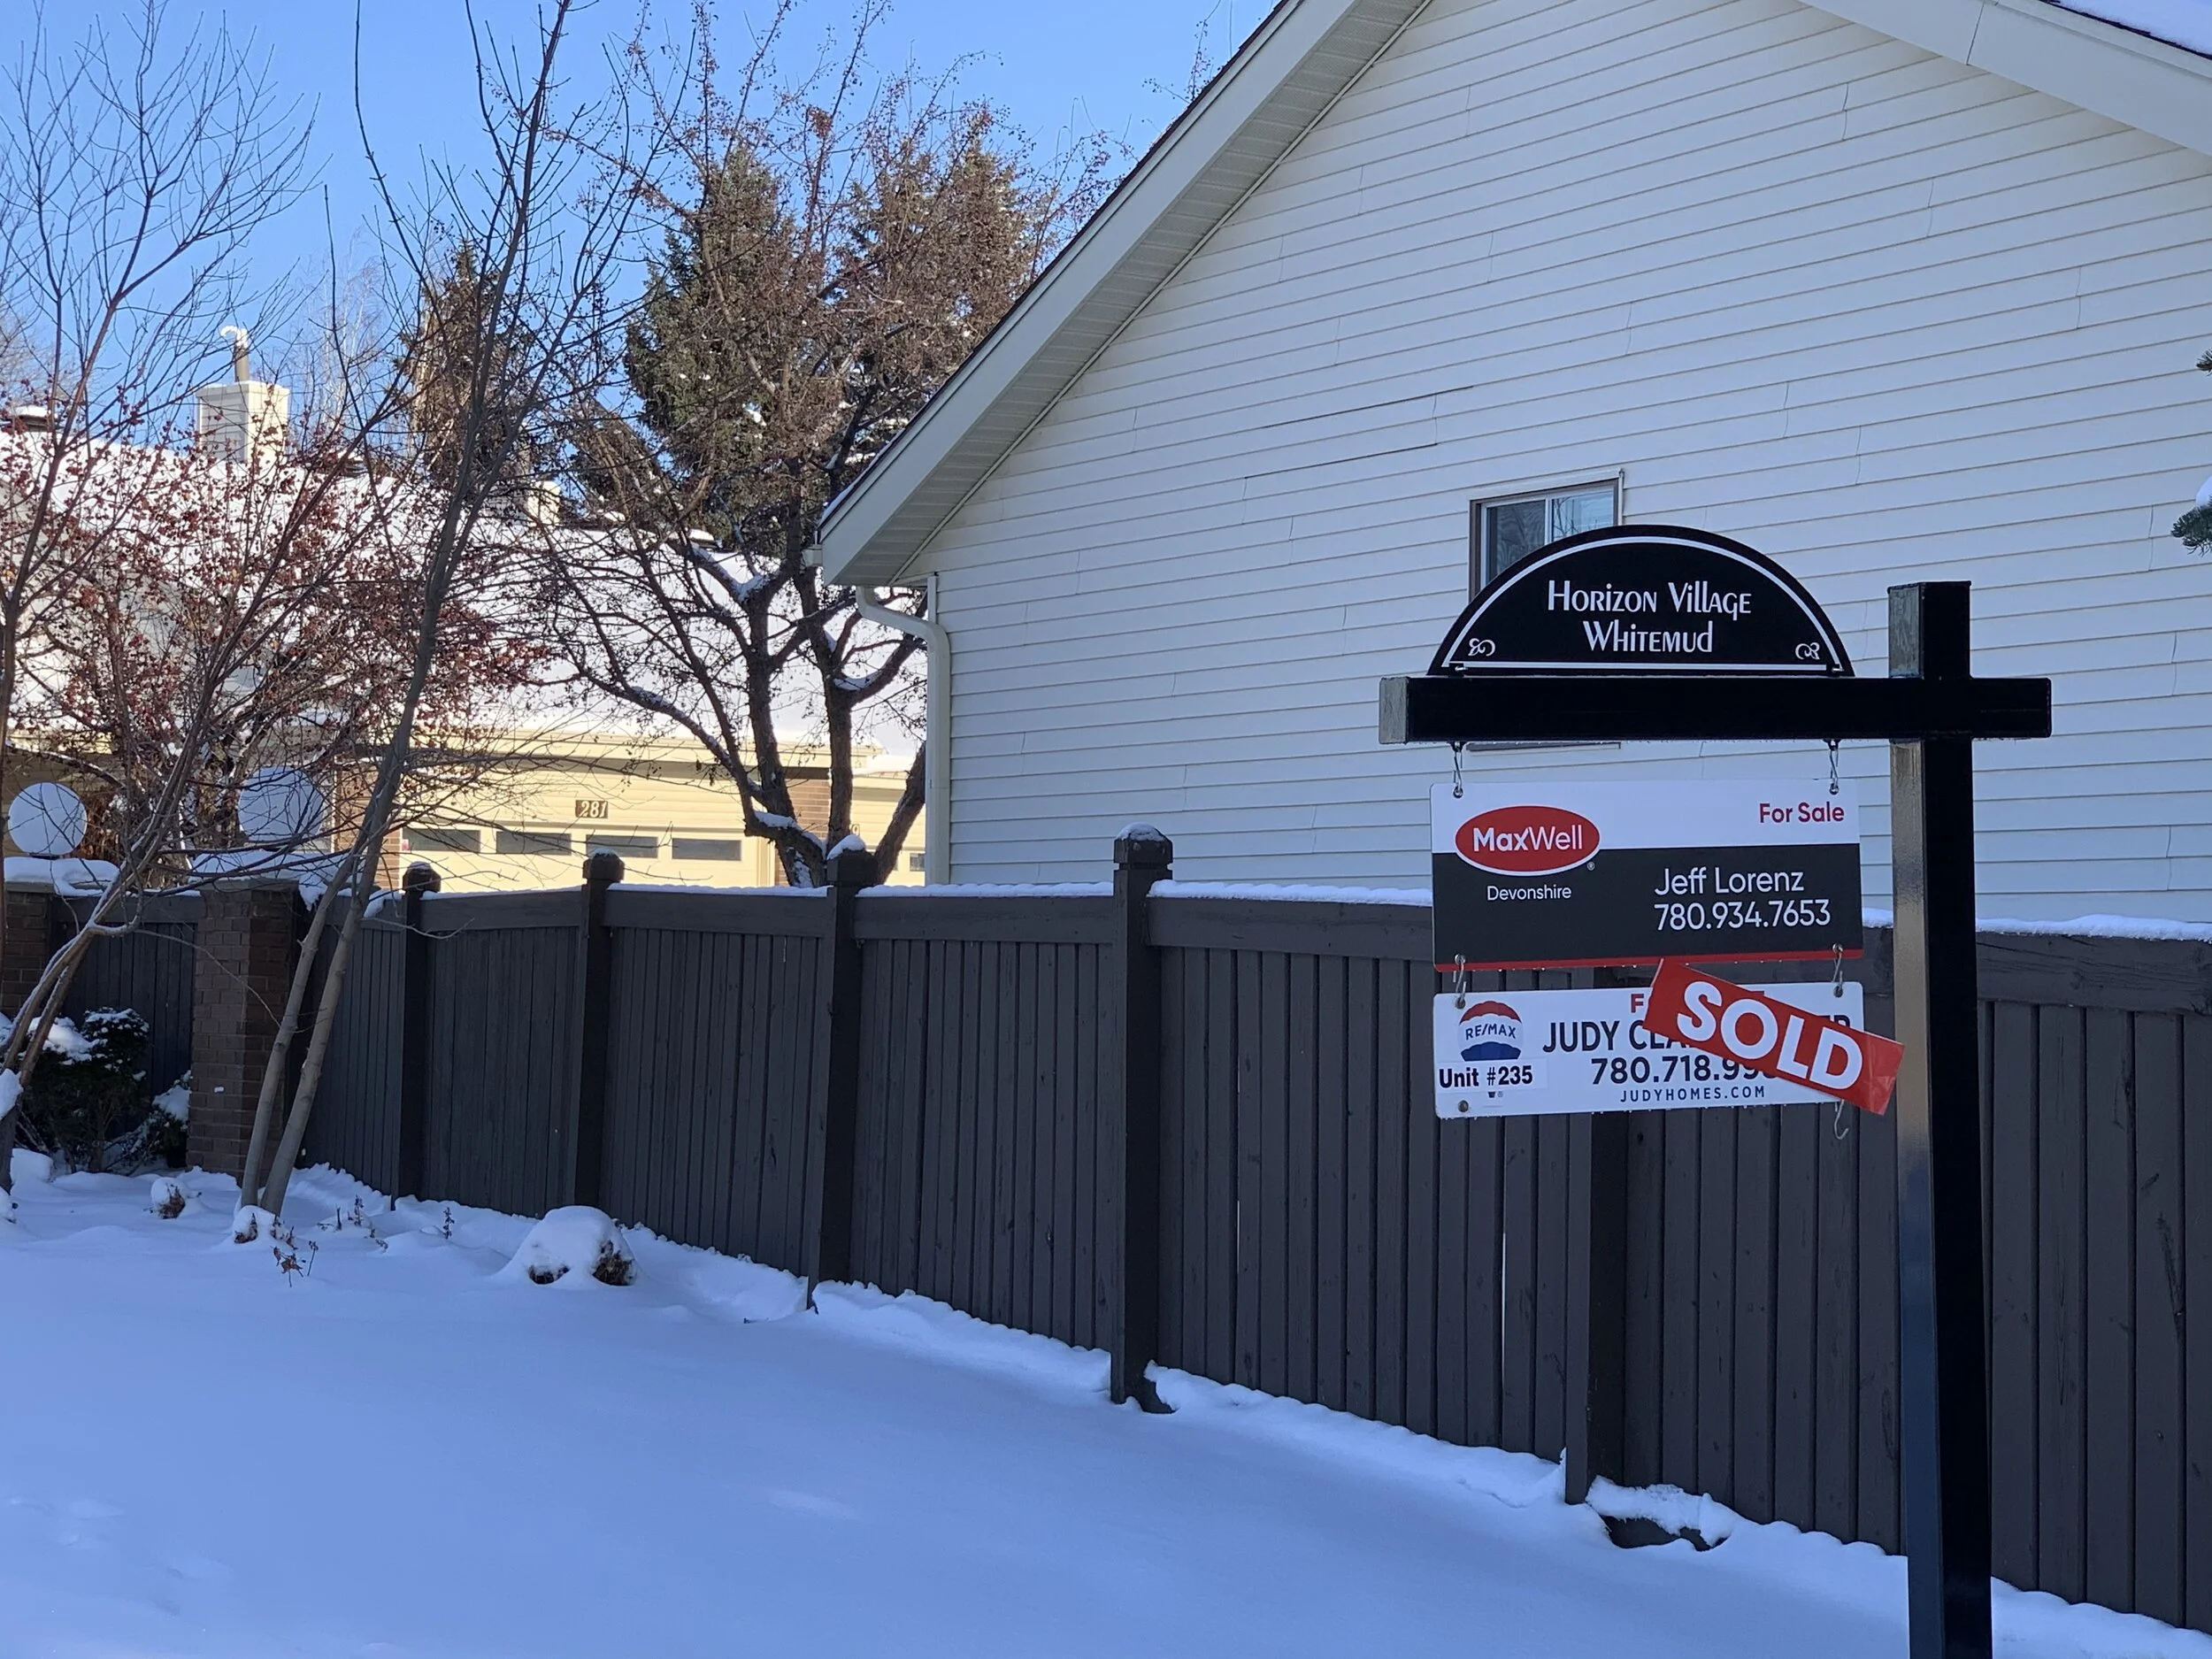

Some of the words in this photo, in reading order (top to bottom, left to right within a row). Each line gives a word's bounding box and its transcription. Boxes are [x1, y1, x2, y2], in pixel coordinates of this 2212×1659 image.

[580, 801, 608, 818] 281
[1759, 803, 1793, 824] For
[1798, 802, 1846, 823] Sale
[1472, 824, 1584, 853] MaxWell
[1654, 867, 1708, 896] Jeff
[1714, 866, 1805, 895] Lorenz
[1486, 885, 1572, 902] Devonshire
[1654, 898, 1832, 932] 780.934.7653
[1465, 1023, 1517, 1041] RE/MAX
[1542, 1020, 1620, 1053] JUDY
[1677, 980, 1863, 1091] SOLD
[1439, 1067, 1479, 1088] Unit
[1486, 1064, 1533, 1087] #235
[1620, 1085, 1765, 1102] JUDYHOMES.COM
